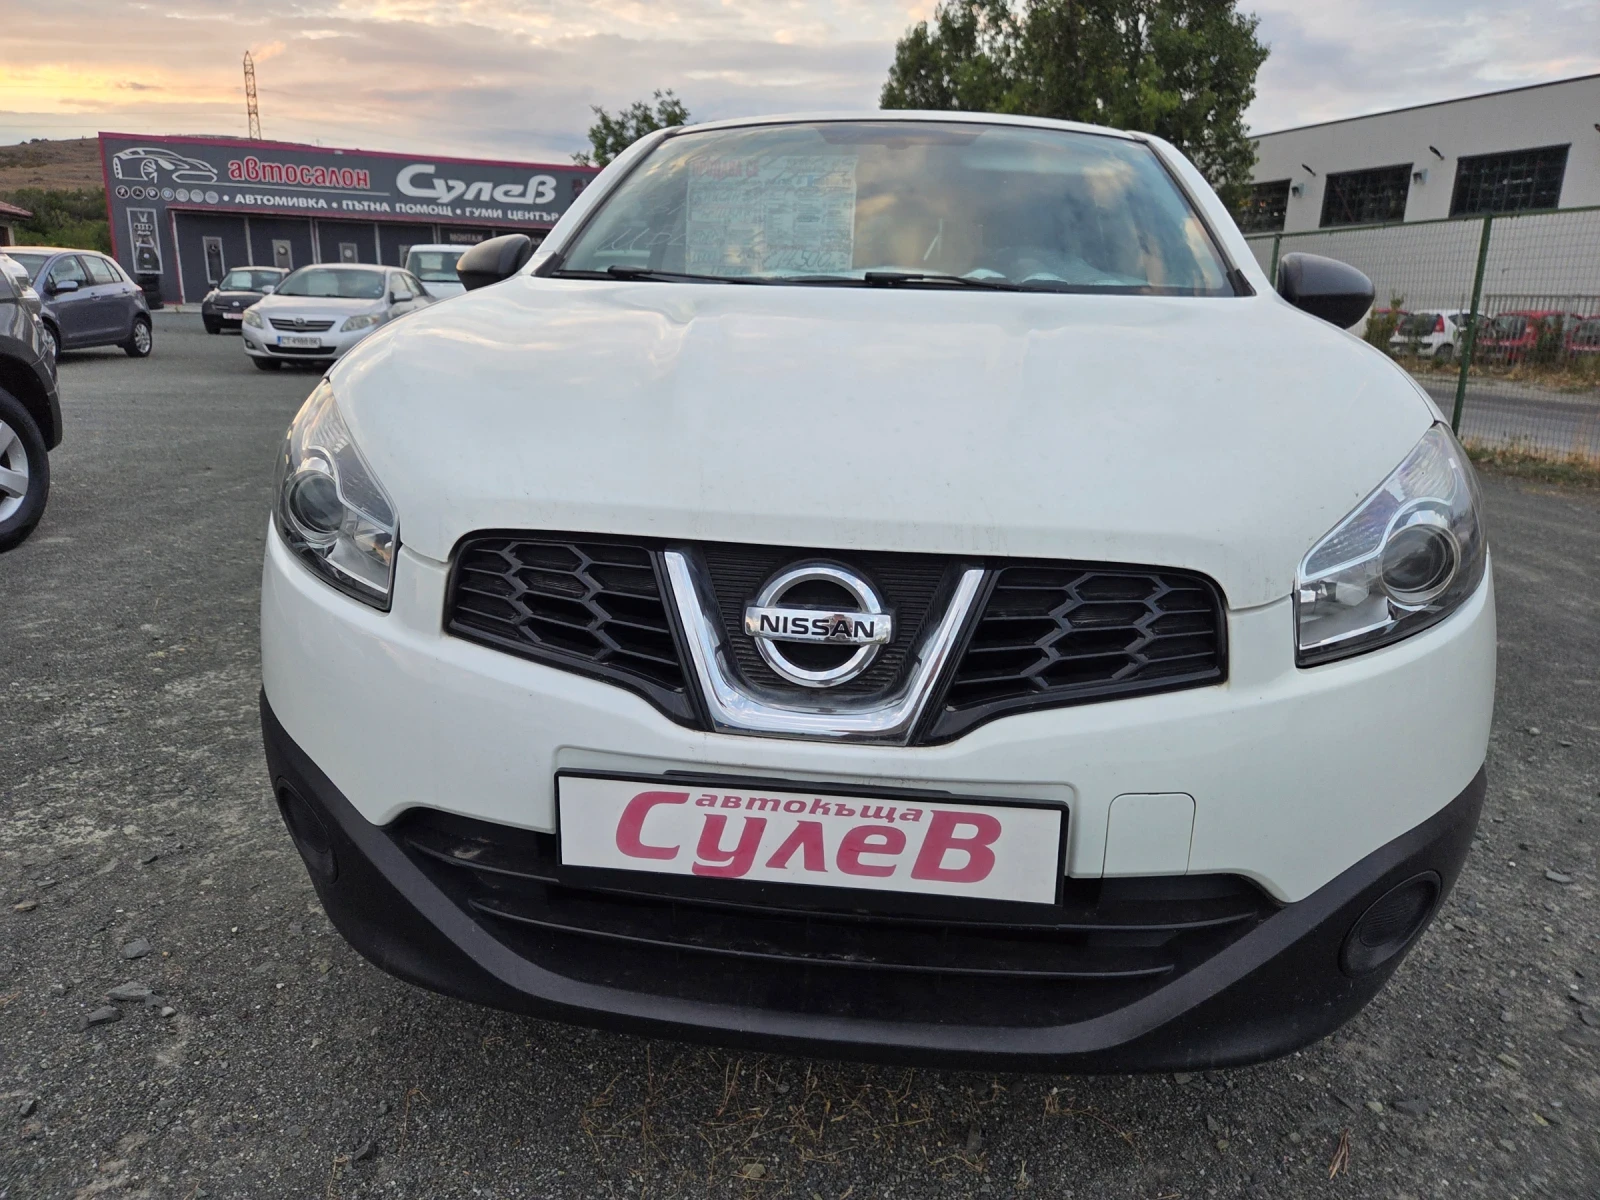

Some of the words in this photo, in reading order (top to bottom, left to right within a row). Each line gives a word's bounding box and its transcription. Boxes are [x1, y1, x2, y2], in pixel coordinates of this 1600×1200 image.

[228, 156, 370, 189] автосалон
[235, 194, 328, 209] АВТОМИВКА
[342, 199, 390, 213] ПЪТНА
[395, 203, 453, 216] ПОМОЩ
[465, 208, 502, 219] ГУМИ
[508, 210, 559, 222] ЦЕНТЪР
[760, 614, 875, 638] NISSAN
[695, 793, 923, 823] автокъща
